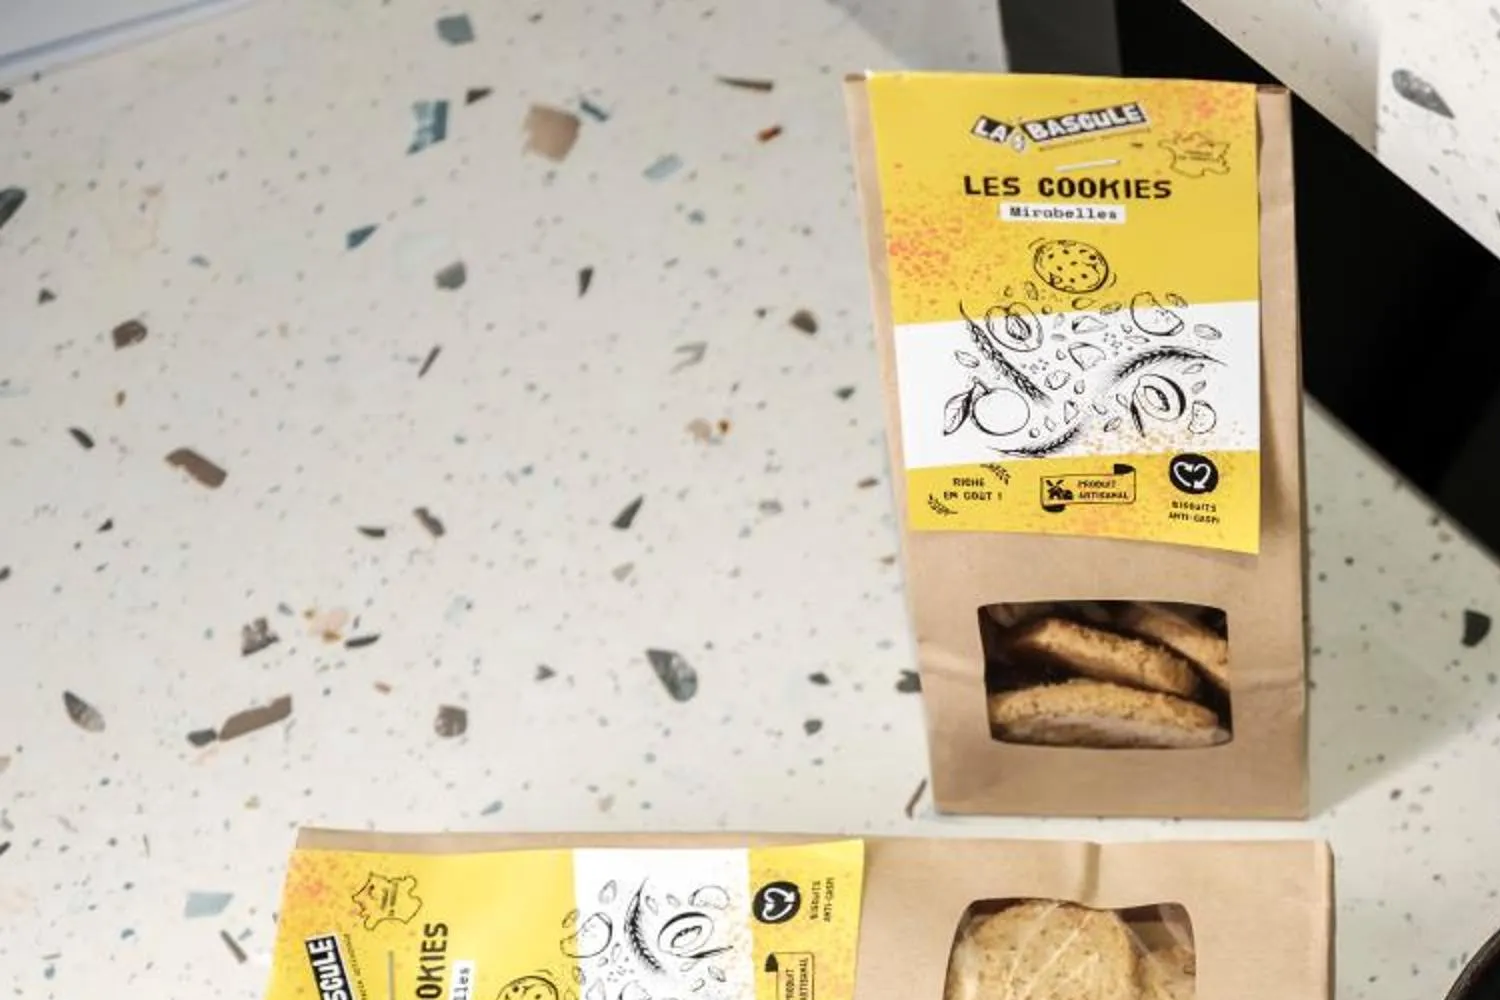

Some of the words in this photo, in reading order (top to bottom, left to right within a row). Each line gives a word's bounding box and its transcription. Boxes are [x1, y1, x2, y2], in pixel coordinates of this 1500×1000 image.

[973, 116, 1008, 143] LA
[1025, 104, 1145, 142] BASCULE
[963, 175, 1021, 197] LES
[1038, 177, 1173, 200] COOKIES
[1009, 206, 1118, 221] Mirabelles
[952, 477, 986, 488] RICHE
[1077, 480, 1117, 489] PRODUIT
[1078, 491, 1130, 500] ARTISANAL
